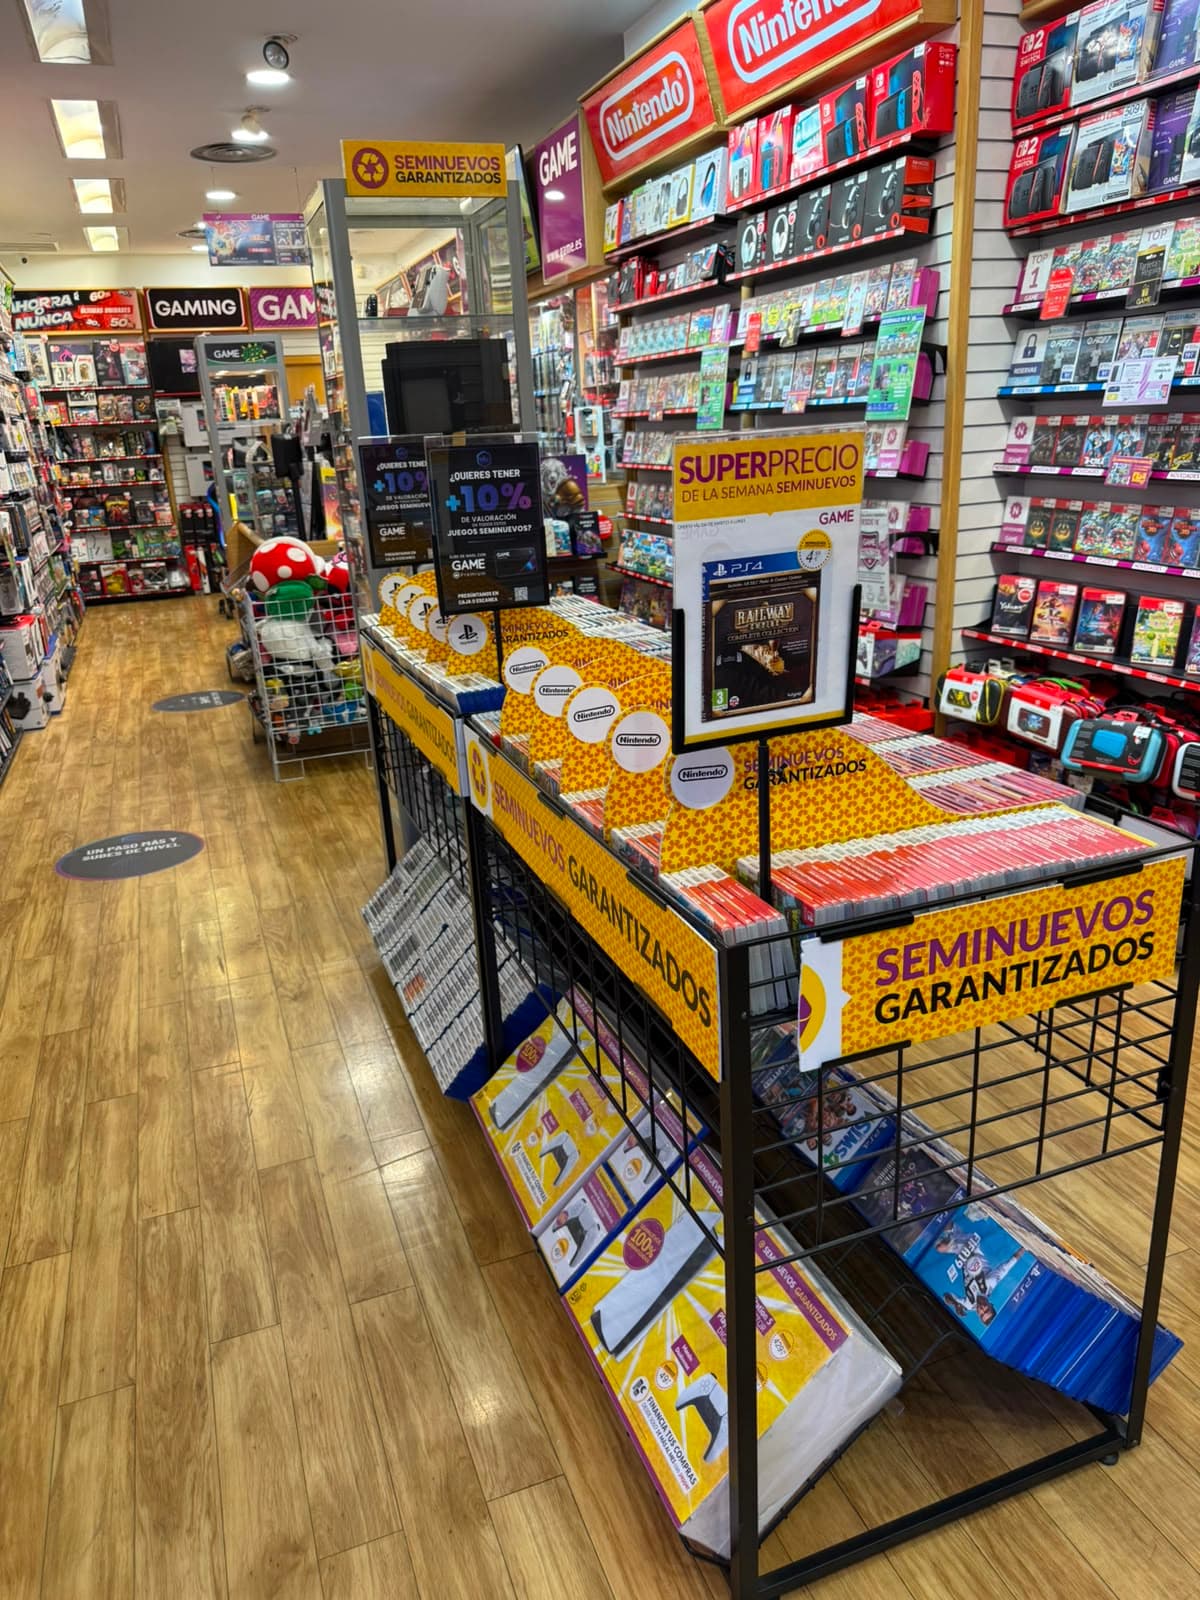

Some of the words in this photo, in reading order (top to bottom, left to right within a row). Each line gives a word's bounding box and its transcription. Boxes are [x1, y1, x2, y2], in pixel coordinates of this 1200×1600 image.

[738, 0, 848, 64] Ninten
[1168, 57, 1186, 68] GAME
[606, 76, 685, 146] Nintendo
[394, 155, 500, 171] SEMINUEVOS
[539, 131, 578, 186] GAME
[395, 171, 501, 184] GARANTIZADOS
[1163, 174, 1179, 185] GAME
[1147, 229, 1167, 241] TOP
[1032, 253, 1049, 264] TOP
[1029, 267, 1040, 288] 1
[155, 299, 237, 316] GAMING
[257, 295, 315, 320] GAM
[15, 312, 74, 330] NUNCA
[213, 349, 240, 359] GAME
[679, 444, 859, 485] SUPERPRECIO
[450, 471, 490, 482] ¿QUIERES
[492, 469, 520, 479] TENER
[682, 490, 699, 503] DE
[703, 488, 718, 501] LA
[722, 482, 774, 499] SEMANA
[776, 475, 856, 494] SEMINUEVOS
[445, 482, 532, 513] +10%
[461, 516, 470, 524] DE
[472, 513, 517, 523] VALORACIÓN
[819, 509, 855, 525] GAME
[380, 527, 406, 536] GAME
[447, 528, 478, 537] JUEGOS
[480, 525, 532, 535] SEMINUEVOS?
[452, 559, 486, 571] GAME
[731, 561, 764, 571] PS4
[738, 605, 791, 625] RAILWAY
[512, 663, 542, 672] Nintendo
[717, 692, 724, 704] 3
[577, 709, 611, 719] Nintendo
[619, 736, 659, 744] Nintendo
[682, 767, 724, 778] Nintendo
[743, 759, 866, 790] GRANTIZADOS
[82, 851, 122, 862] SUBES
[125, 847, 141, 855] DE
[144, 842, 181, 852] NIVEL
[86, 847, 104, 856] UN
[107, 842, 138, 853] PASO
[491, 779, 566, 873] SEMINUEVOS
[567, 855, 713, 1028] GARANTIZADOS
[875, 889, 1155, 986] SEMINUEVOS
[874, 932, 1155, 1024] GARANTIZADOS
[629, 1227, 657, 1258] 100%
[763, 1245, 795, 1289] SEMUEVOS
[795, 1285, 835, 1341] GARANTIZADOS
[1012, 1278, 1033, 1303] PS4
[645, 1396, 669, 1432] FINANCIA
[663, 1430, 677, 1447] TUS
[671, 1445, 698, 1485] COMPRAS
